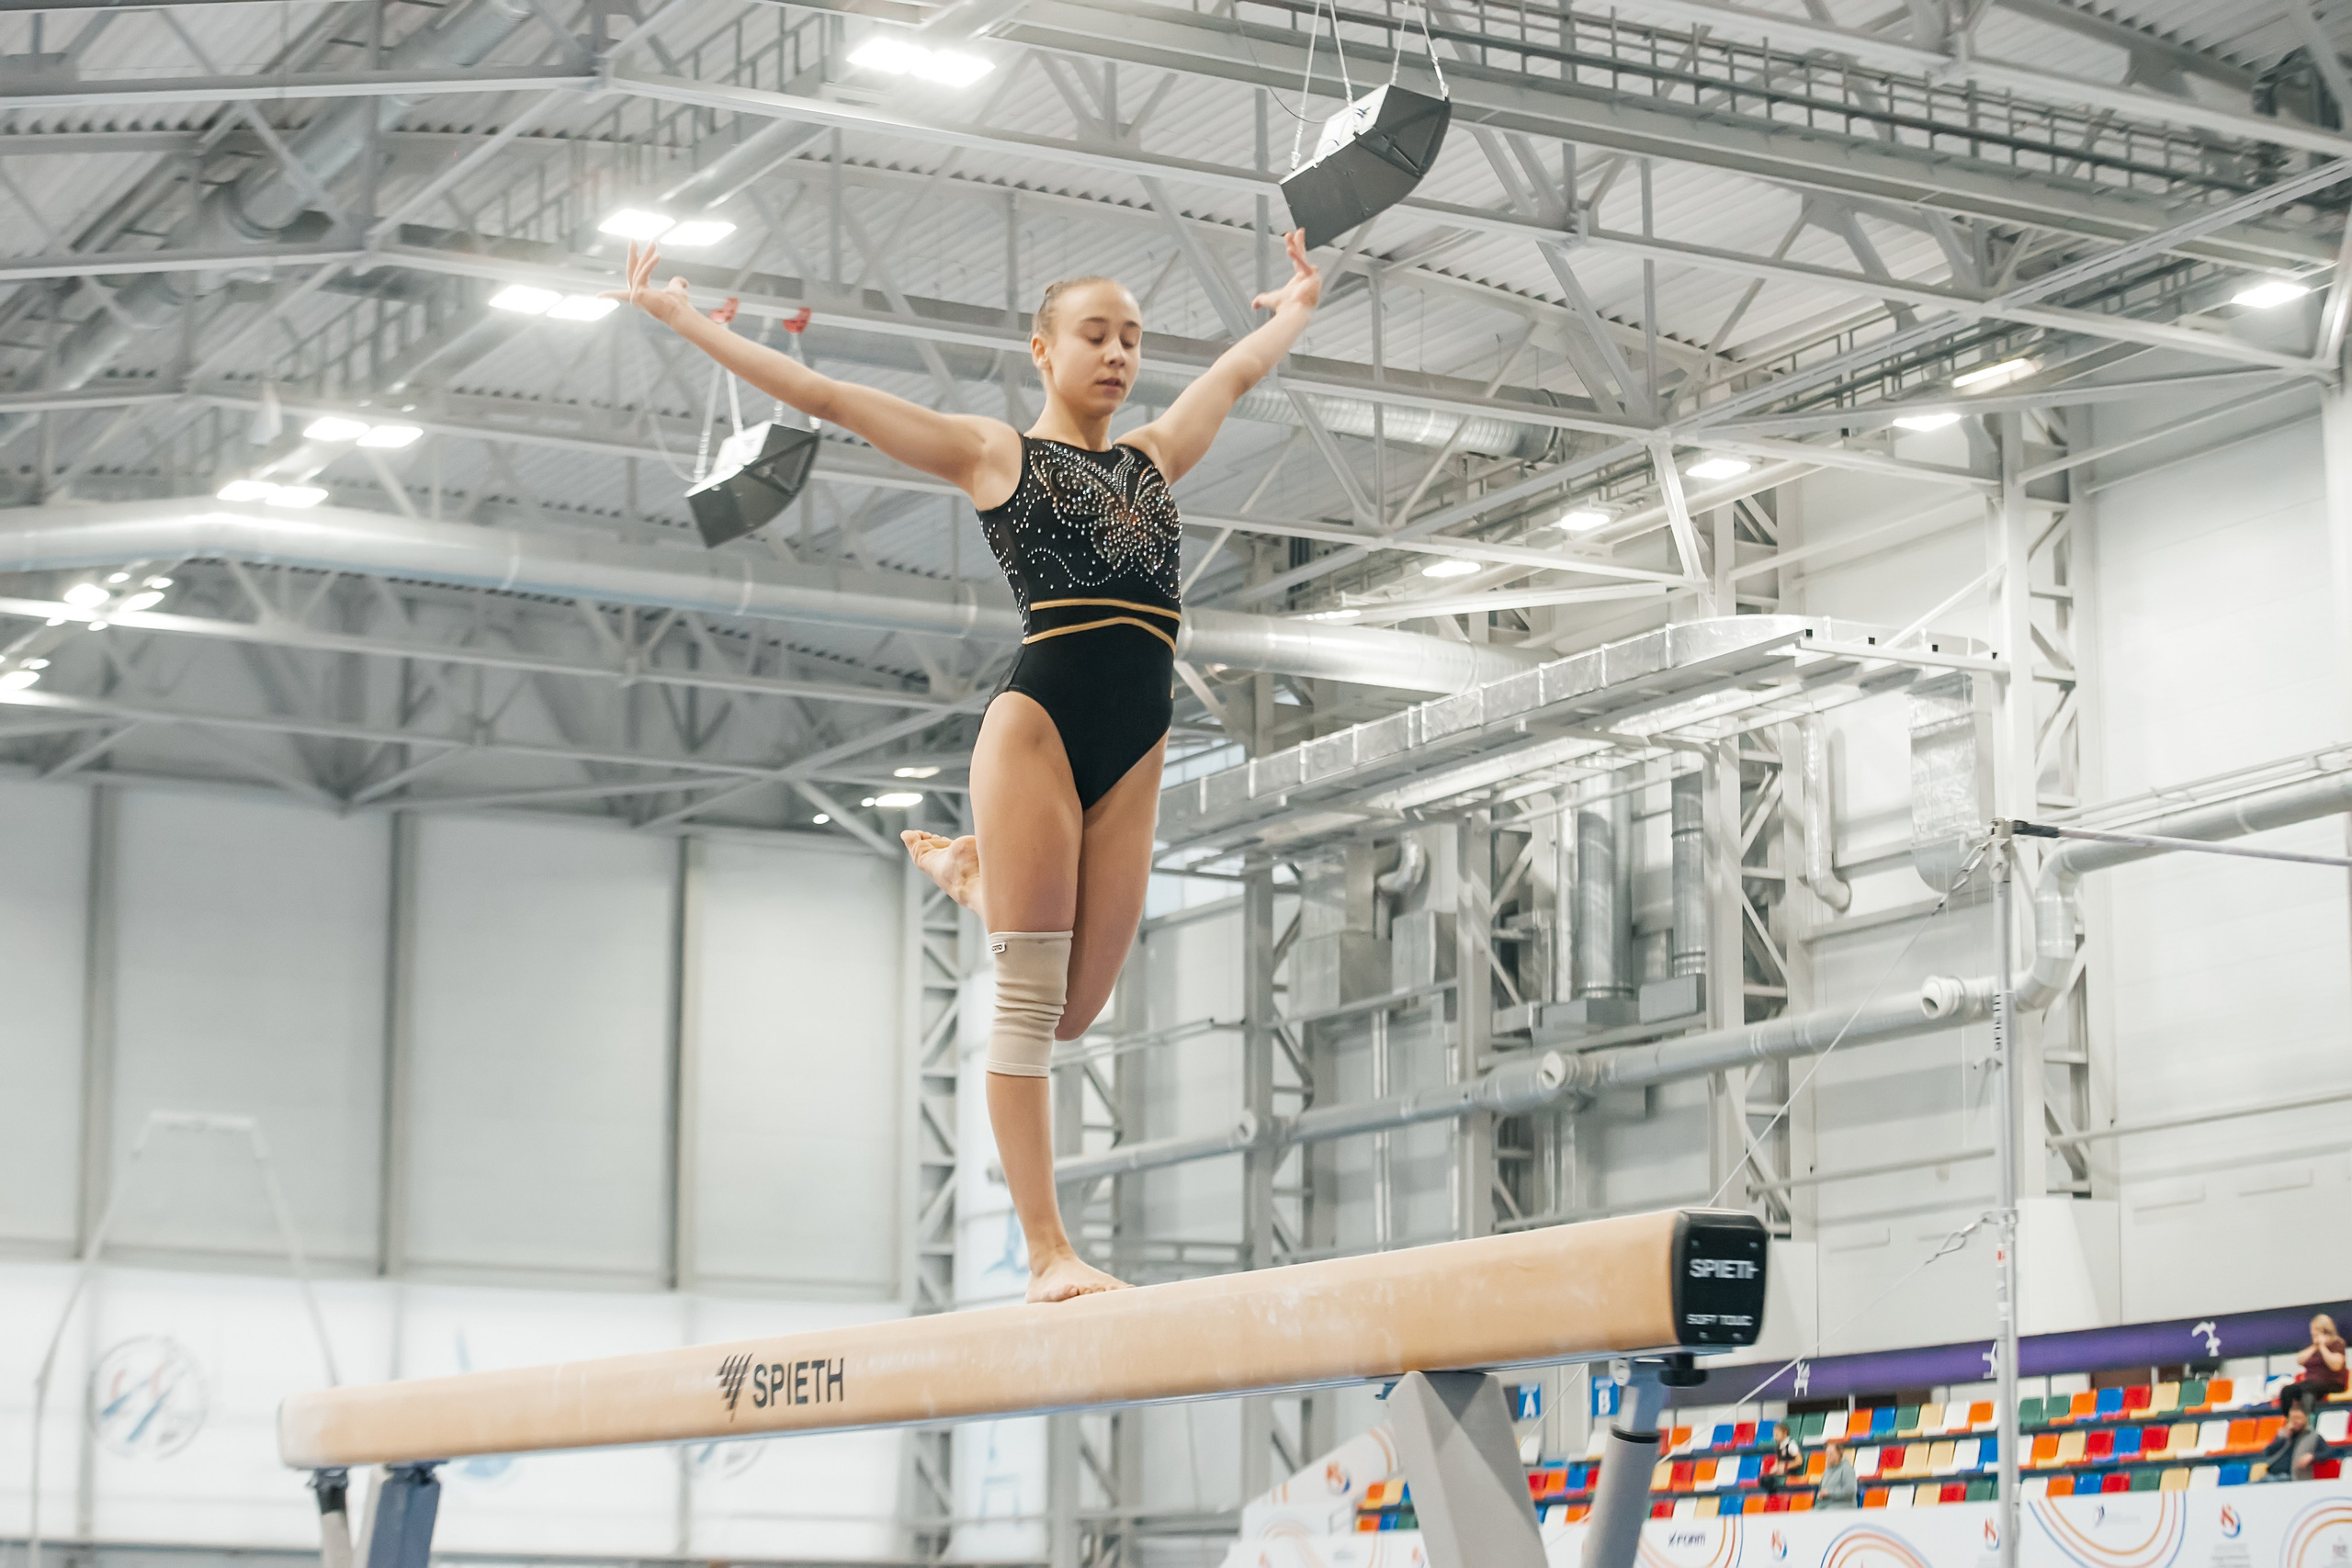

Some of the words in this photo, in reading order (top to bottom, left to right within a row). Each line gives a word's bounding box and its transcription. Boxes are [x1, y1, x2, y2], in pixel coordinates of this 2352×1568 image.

[752, 1356, 845, 1408] SPIETH
[1521, 1393, 1537, 1418] A
[1598, 1388, 1611, 1416] B
